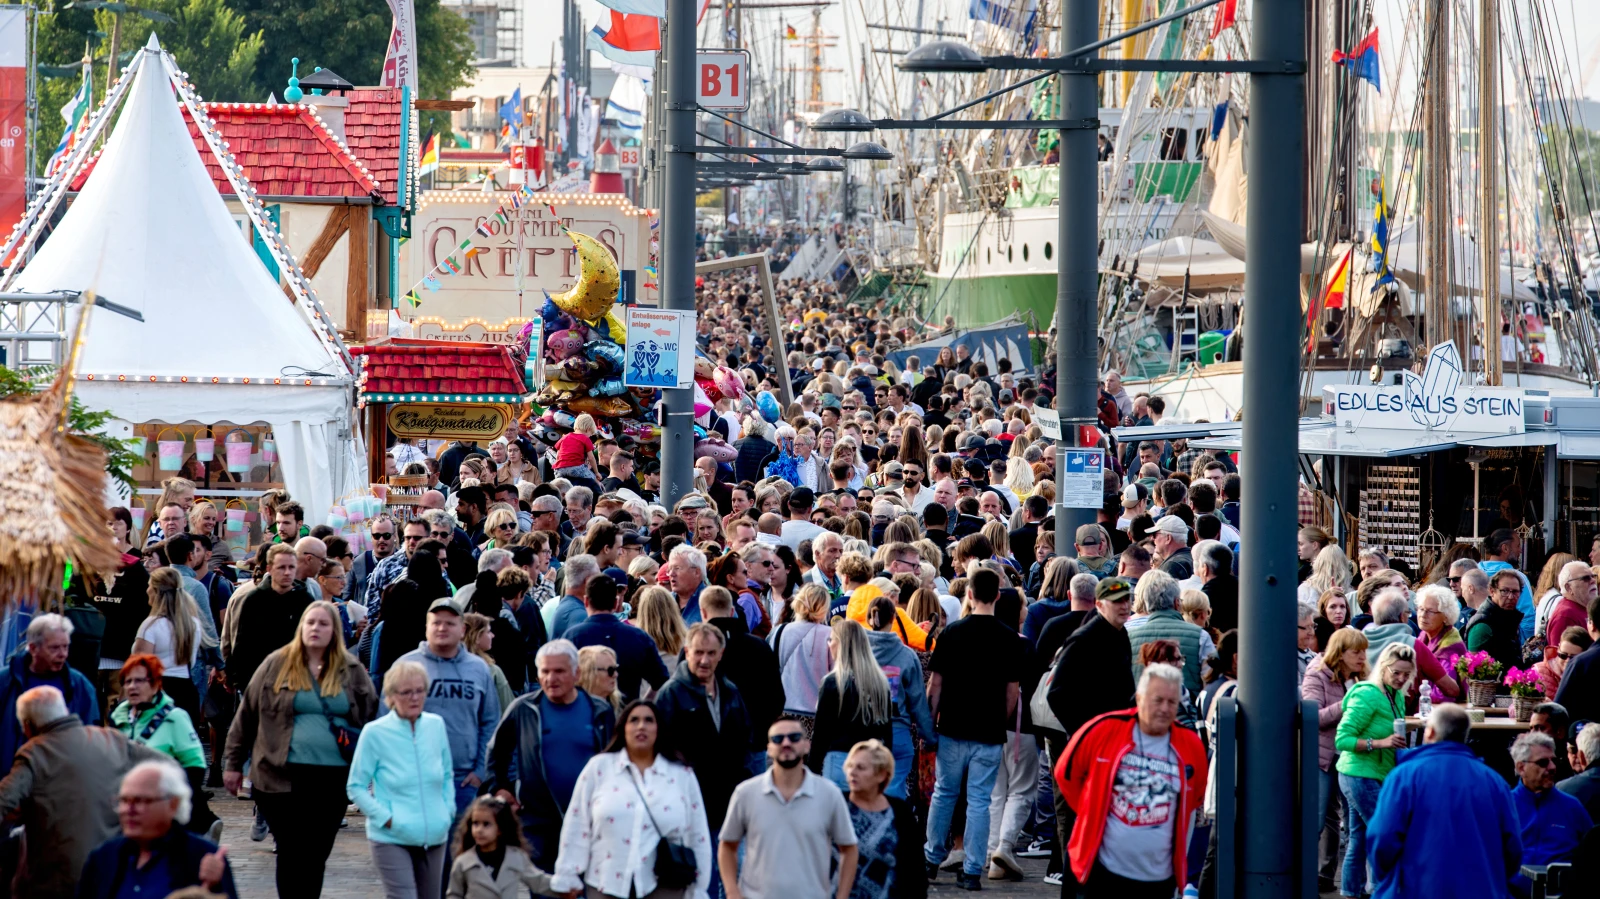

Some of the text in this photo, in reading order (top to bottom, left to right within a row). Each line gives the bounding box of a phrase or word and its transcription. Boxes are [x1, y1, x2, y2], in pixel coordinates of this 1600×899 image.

[701, 63, 739, 97] B1
[622, 150, 638, 164] B3
[506, 209, 542, 219] MINI
[475, 216, 575, 237] GOURMET
[632, 321, 651, 329] anlage
[664, 343, 677, 351] WC
[1338, 393, 1521, 416] EDLES AUS STEIN
[433, 408, 466, 417] Reinhard
[395, 411, 498, 435] Königsmandel
[93, 595, 122, 604] CREW
